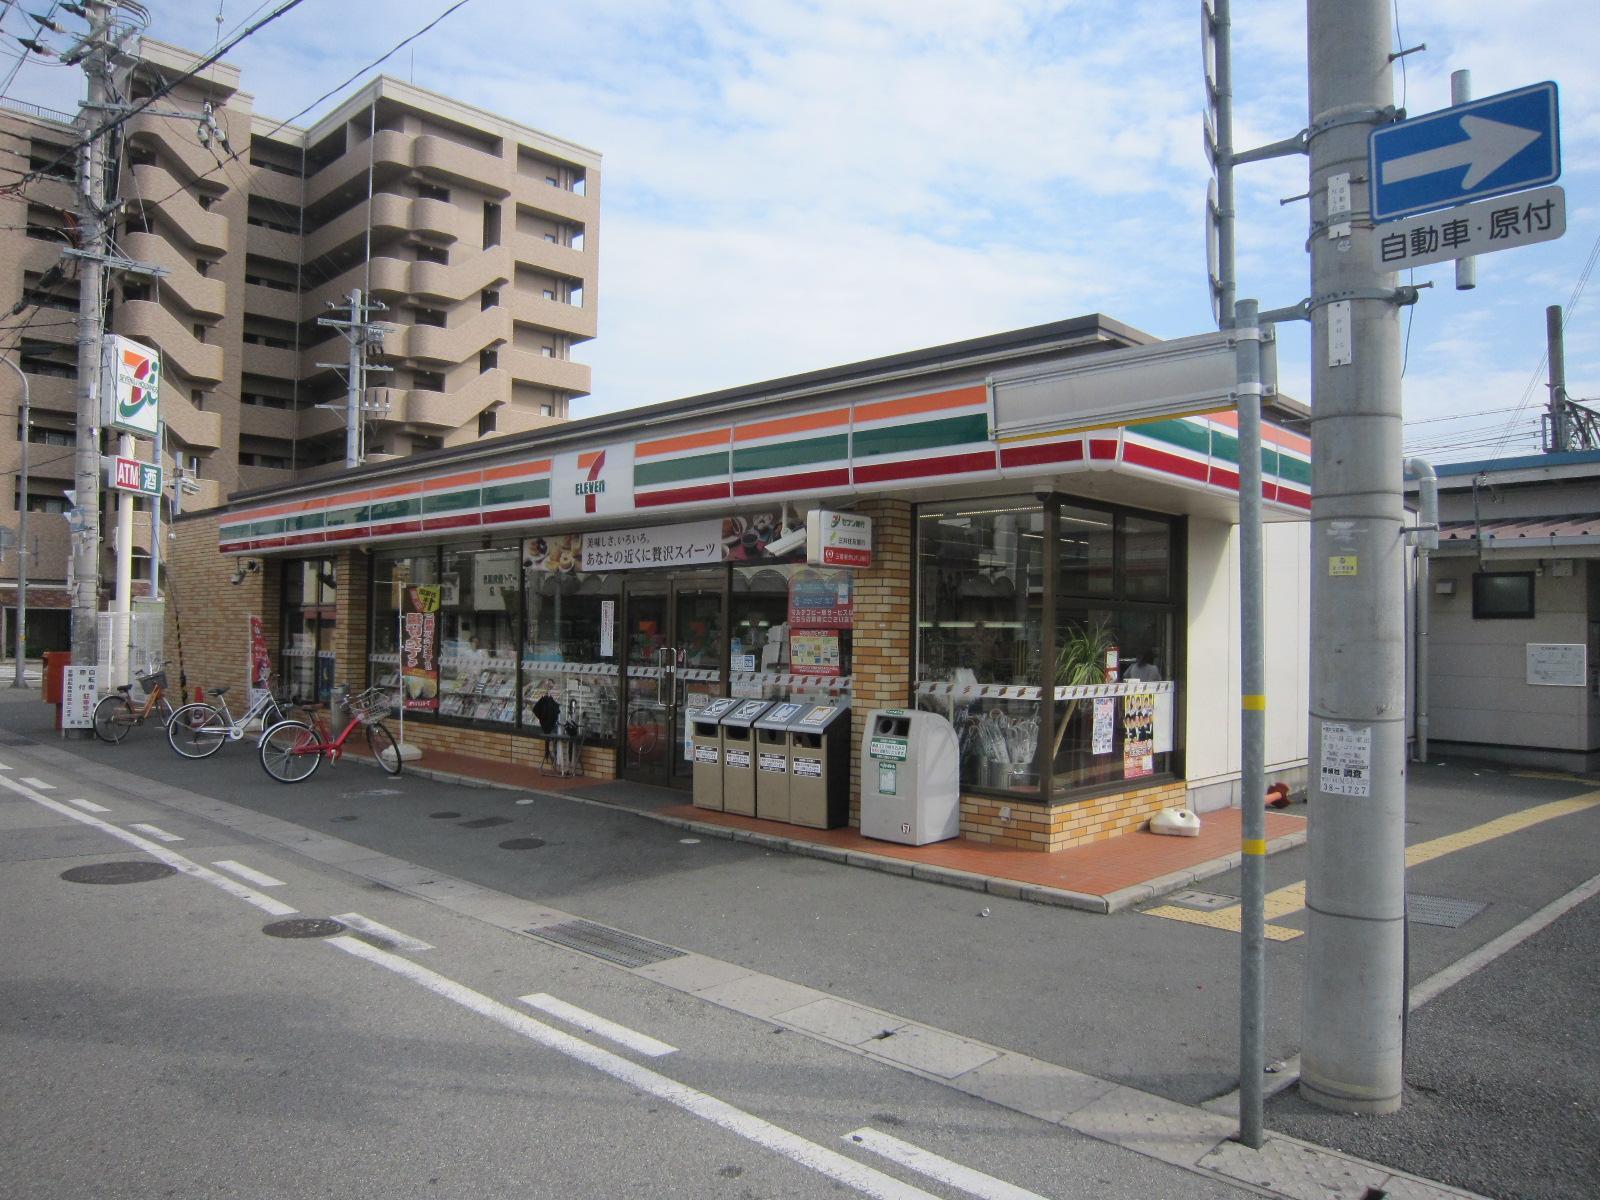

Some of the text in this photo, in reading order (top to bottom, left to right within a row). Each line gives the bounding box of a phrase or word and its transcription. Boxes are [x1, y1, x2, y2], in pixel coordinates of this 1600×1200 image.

[1381, 199, 1555, 263] 自動車・原付
[117, 462, 139, 486] ATM
[143, 467, 157, 490] 酒
[586, 544, 715, 566] あなたの近くに贅沢スイーツ
[1323, 782, 1366, 795] 38-1727
